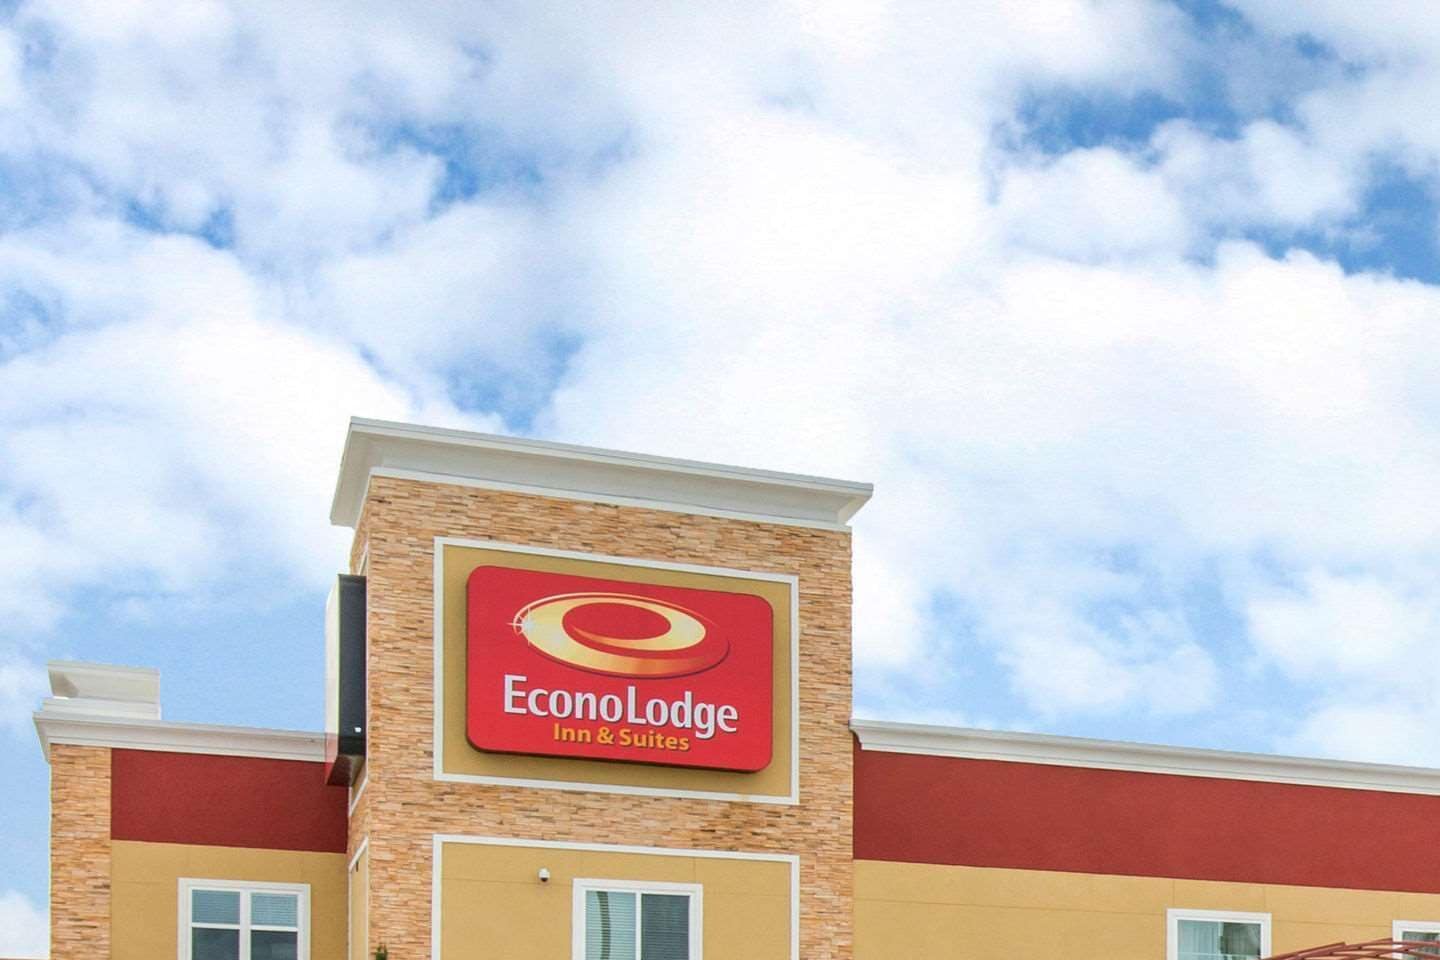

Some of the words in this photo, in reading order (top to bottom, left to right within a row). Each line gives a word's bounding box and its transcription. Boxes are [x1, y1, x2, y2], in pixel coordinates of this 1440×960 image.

[503, 673, 738, 740] EconoLodge
[553, 722, 591, 744] Inn
[596, 725, 614, 746] &
[620, 728, 690, 752] Suites
